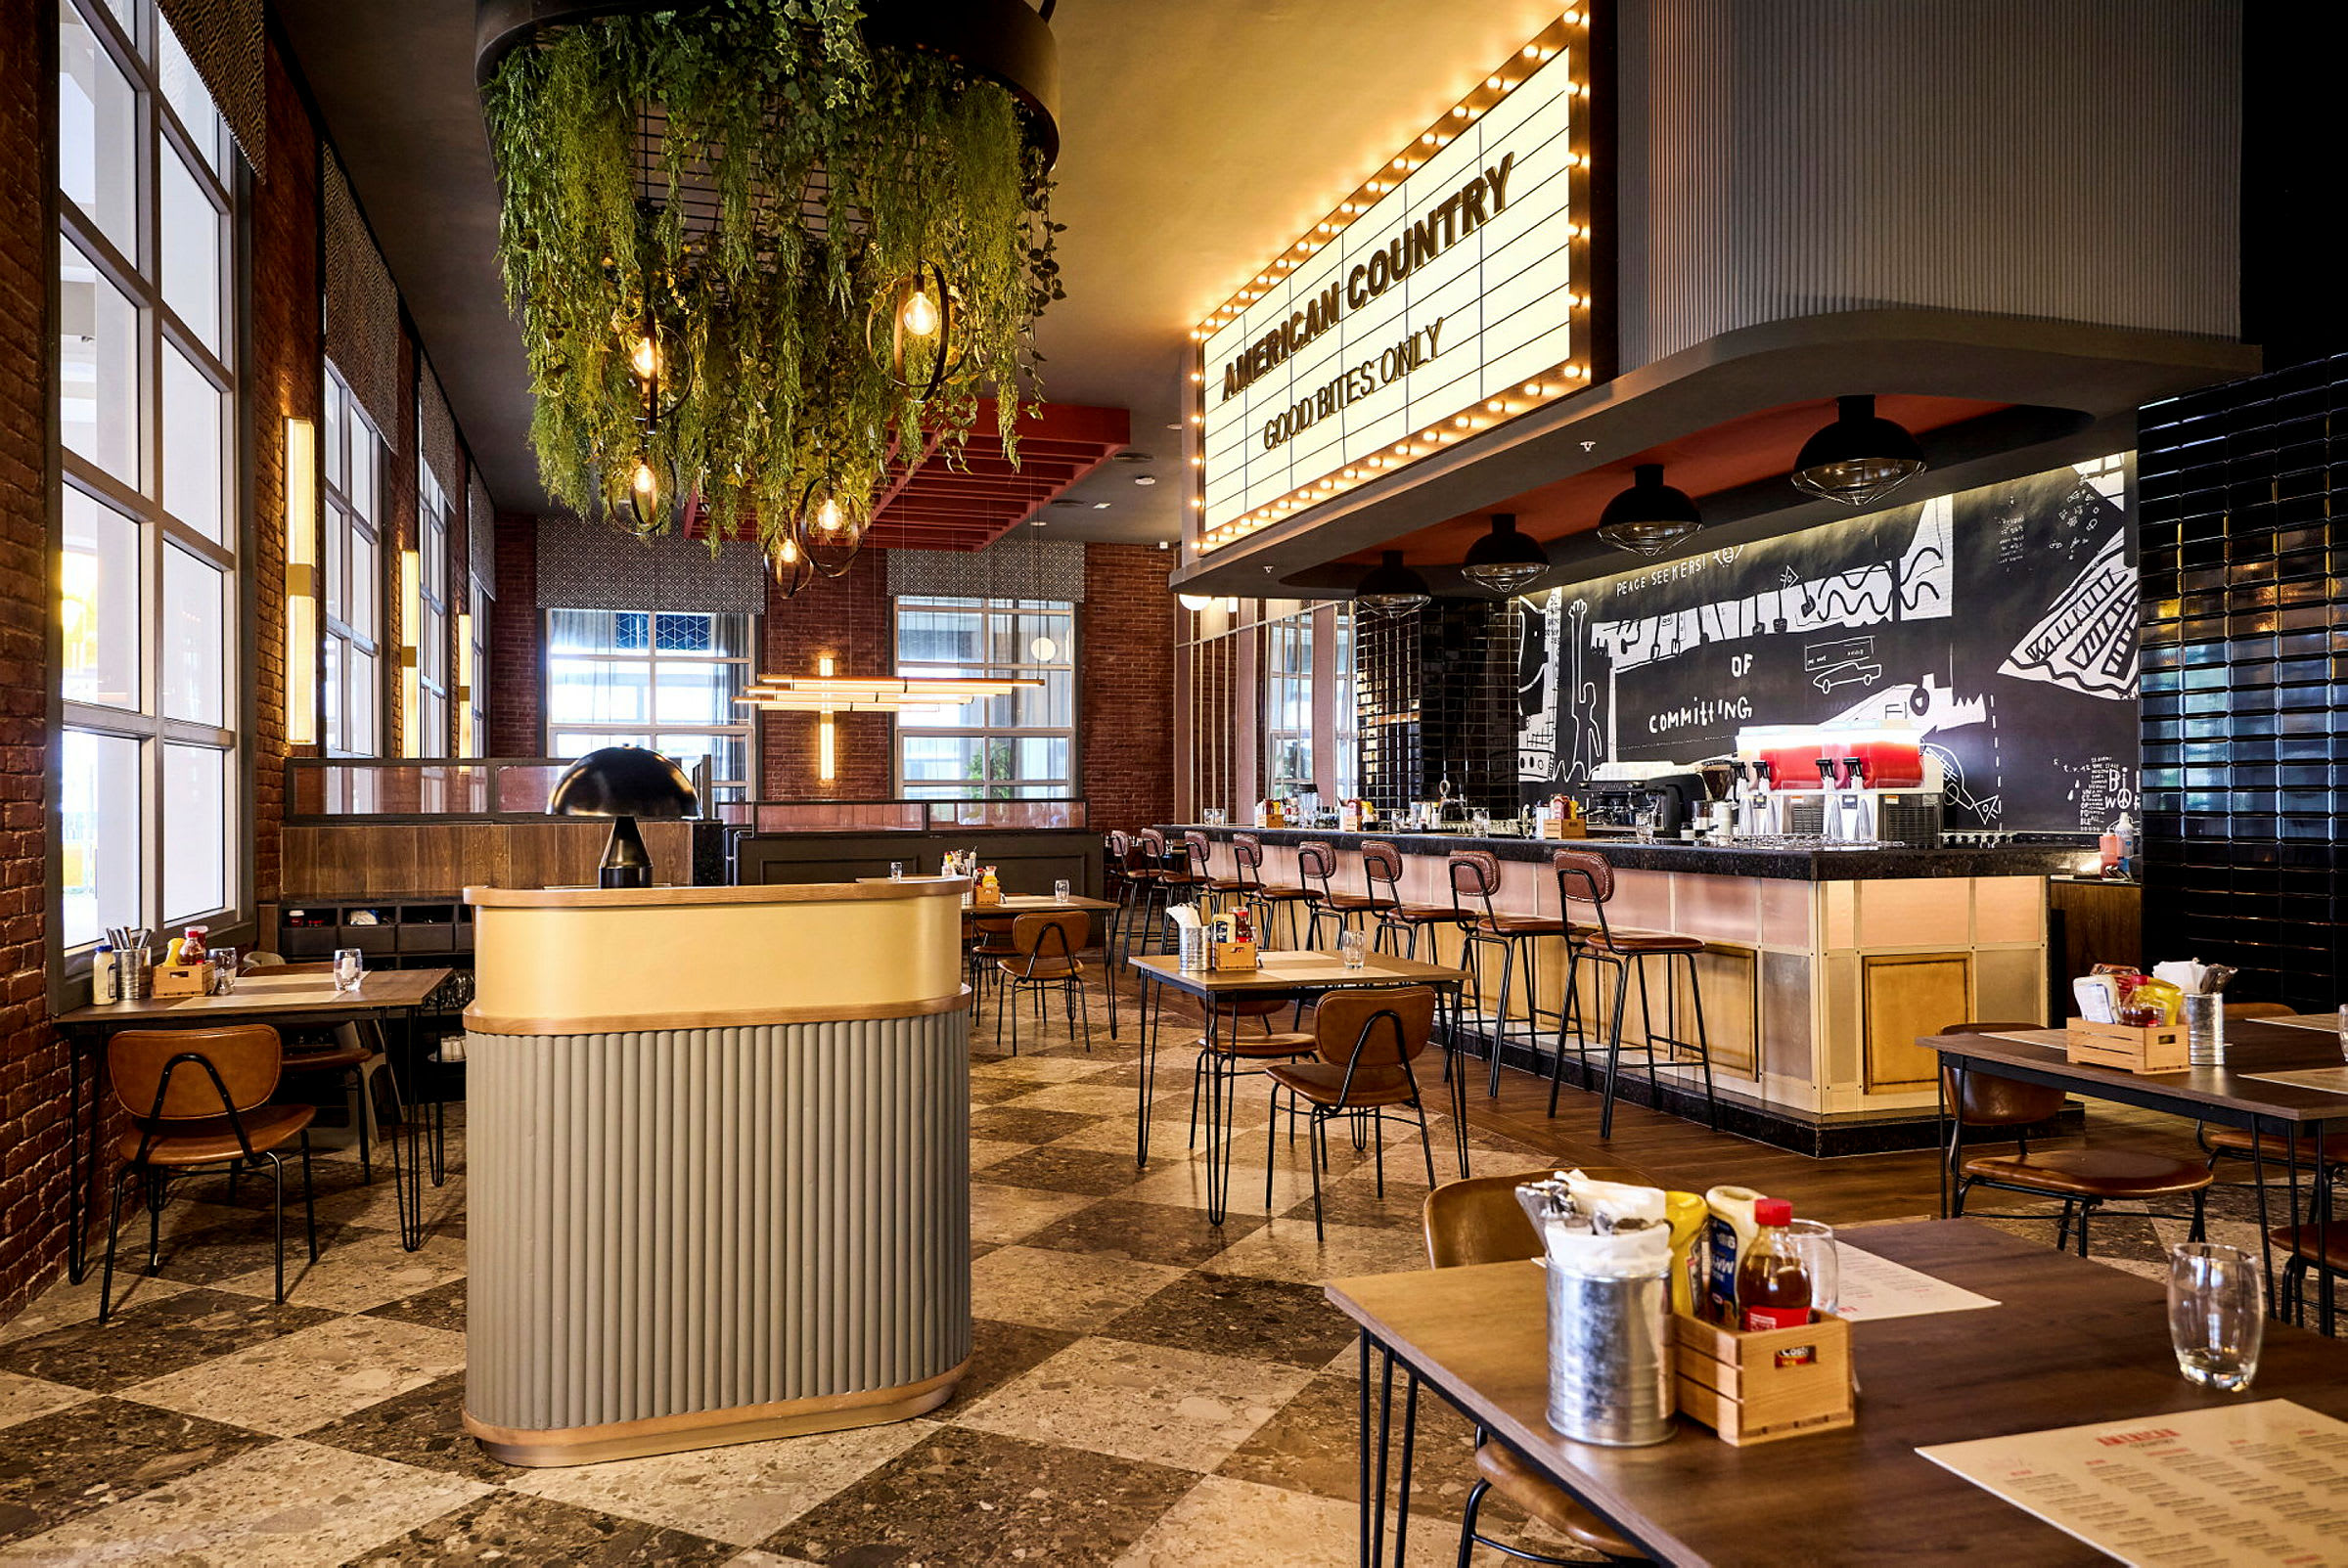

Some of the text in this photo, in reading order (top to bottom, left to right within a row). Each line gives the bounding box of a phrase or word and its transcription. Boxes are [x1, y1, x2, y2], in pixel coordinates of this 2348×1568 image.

[1222, 151, 1515, 402] AMERICAN COUNTRY
[1263, 316, 1446, 451] GOOD BITES ONLY
[1731, 653, 1754, 678] OF
